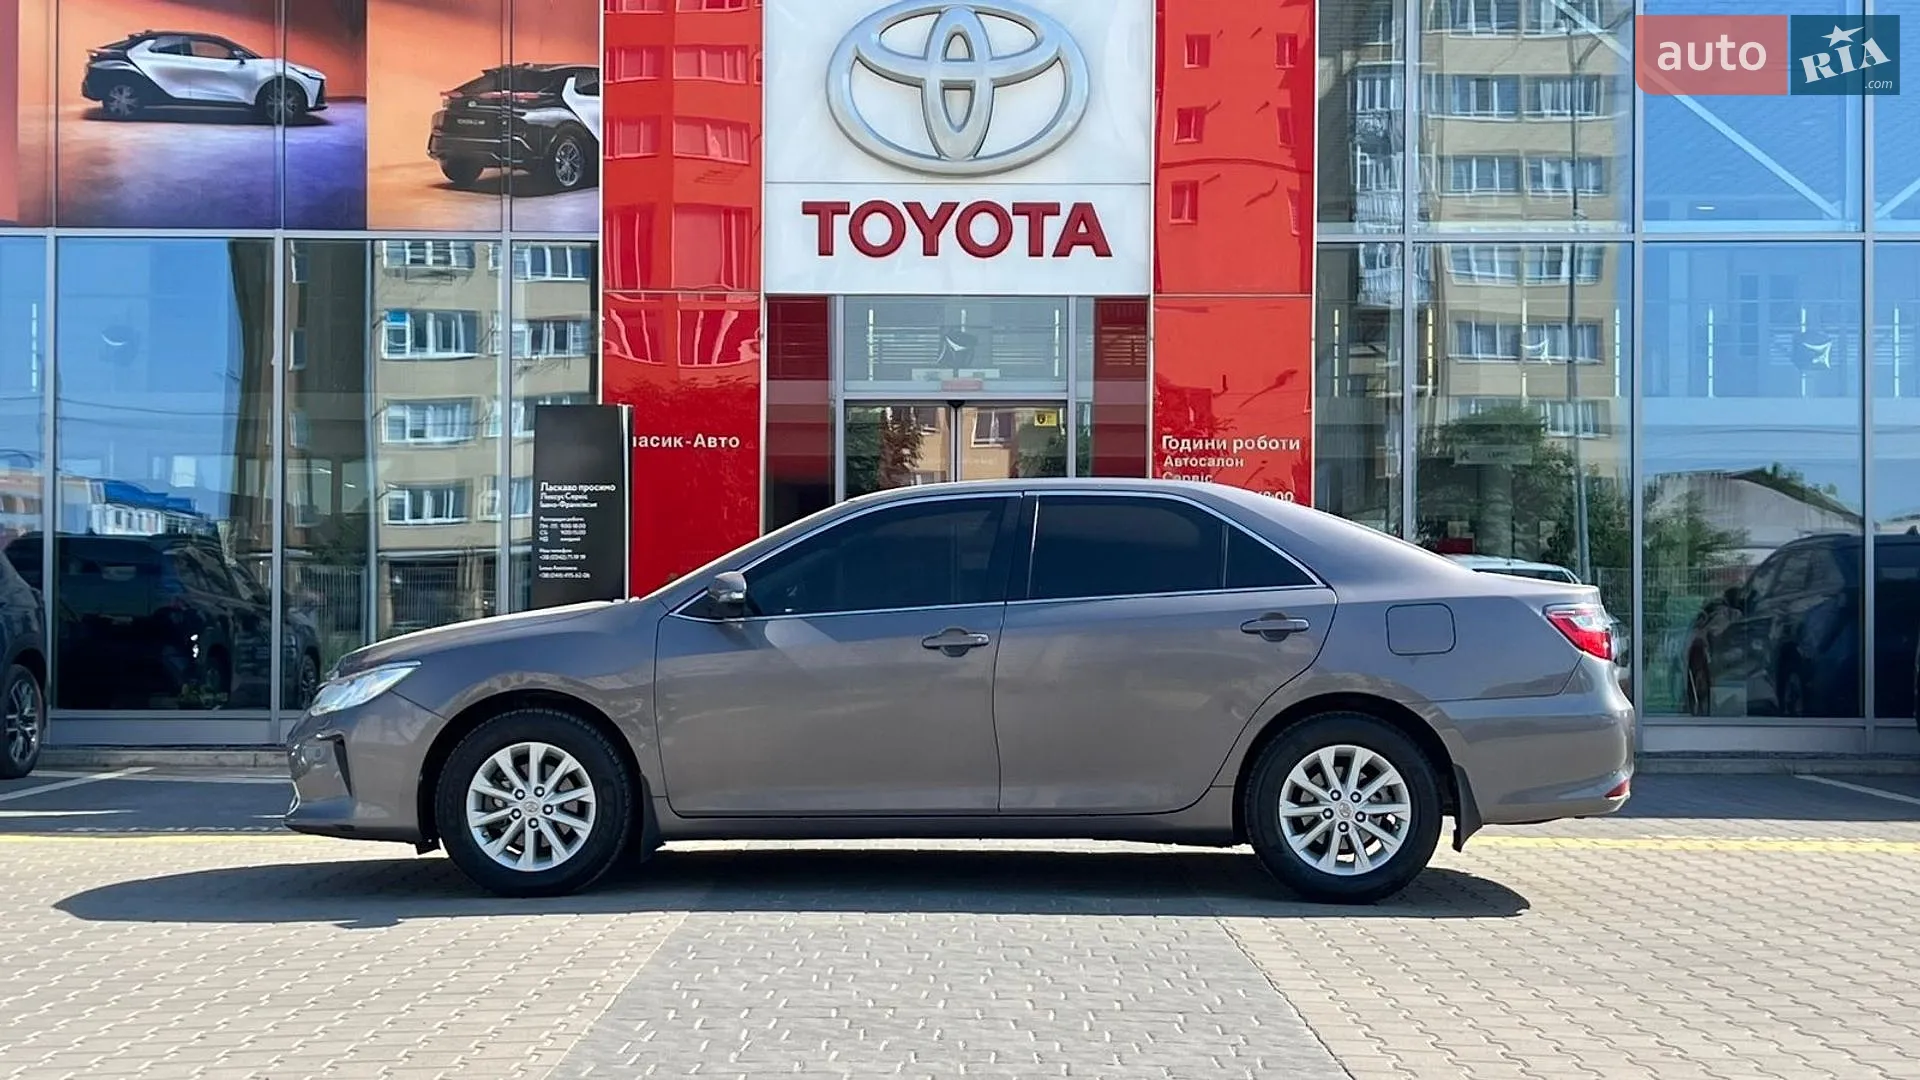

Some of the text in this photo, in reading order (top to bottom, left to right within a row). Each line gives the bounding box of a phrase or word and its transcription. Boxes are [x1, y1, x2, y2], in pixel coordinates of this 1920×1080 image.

[802, 200, 1113, 257] TOYOTA
[1161, 435, 1301, 453] Години роботи
[1163, 455, 1245, 467] Автосалон
